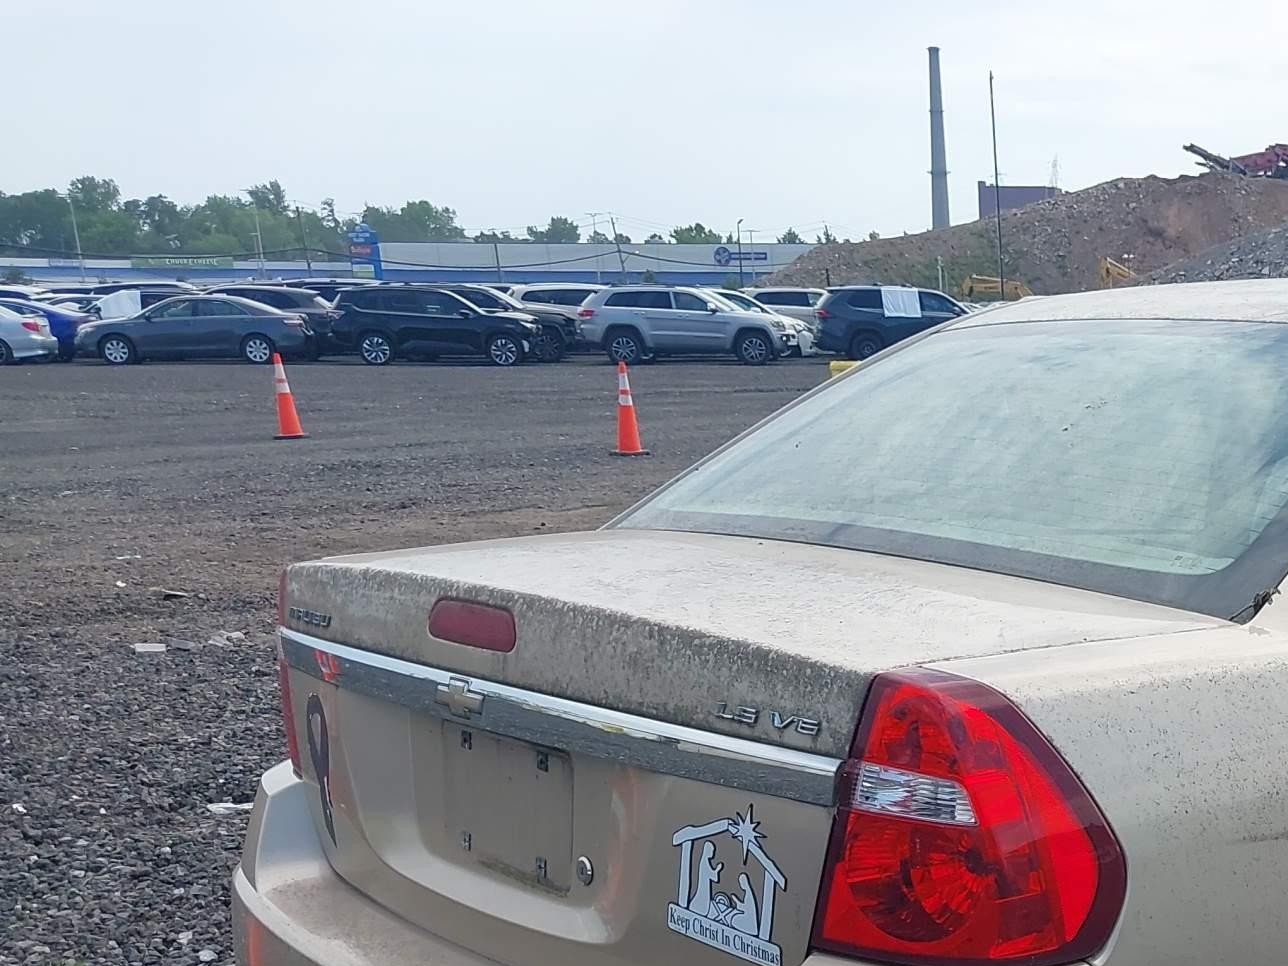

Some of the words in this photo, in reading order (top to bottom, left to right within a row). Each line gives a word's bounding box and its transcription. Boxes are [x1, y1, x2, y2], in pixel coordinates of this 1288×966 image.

[713, 701, 758, 726] LS
[769, 710, 820, 736] V6
[669, 907, 691, 934] Keep
[692, 918, 719, 942] Christ
[721, 928, 731, 948] In
[733, 935, 780, 966] Christmas
